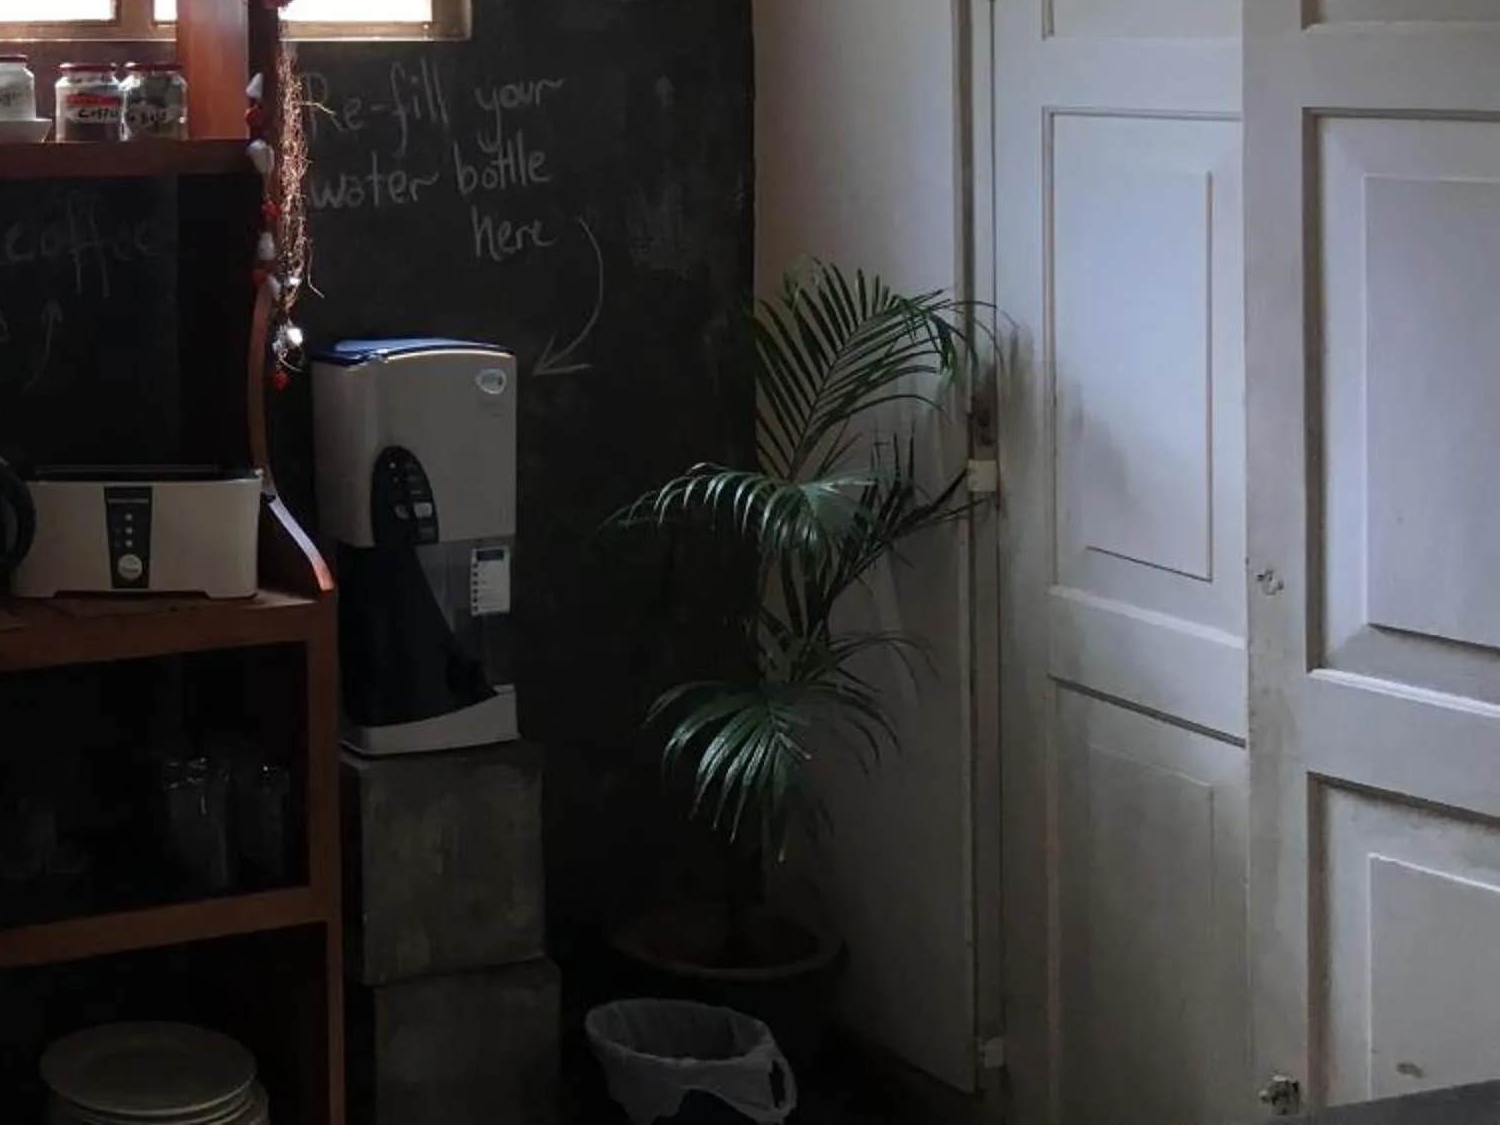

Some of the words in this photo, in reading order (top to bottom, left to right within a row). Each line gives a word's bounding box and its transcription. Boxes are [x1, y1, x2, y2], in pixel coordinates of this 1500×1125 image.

[475, 77, 564, 153] your
[309, 150, 441, 210] water
[454, 130, 550, 197] bottle
[0, 187, 168, 301] coffee
[471, 205, 555, 262] here
